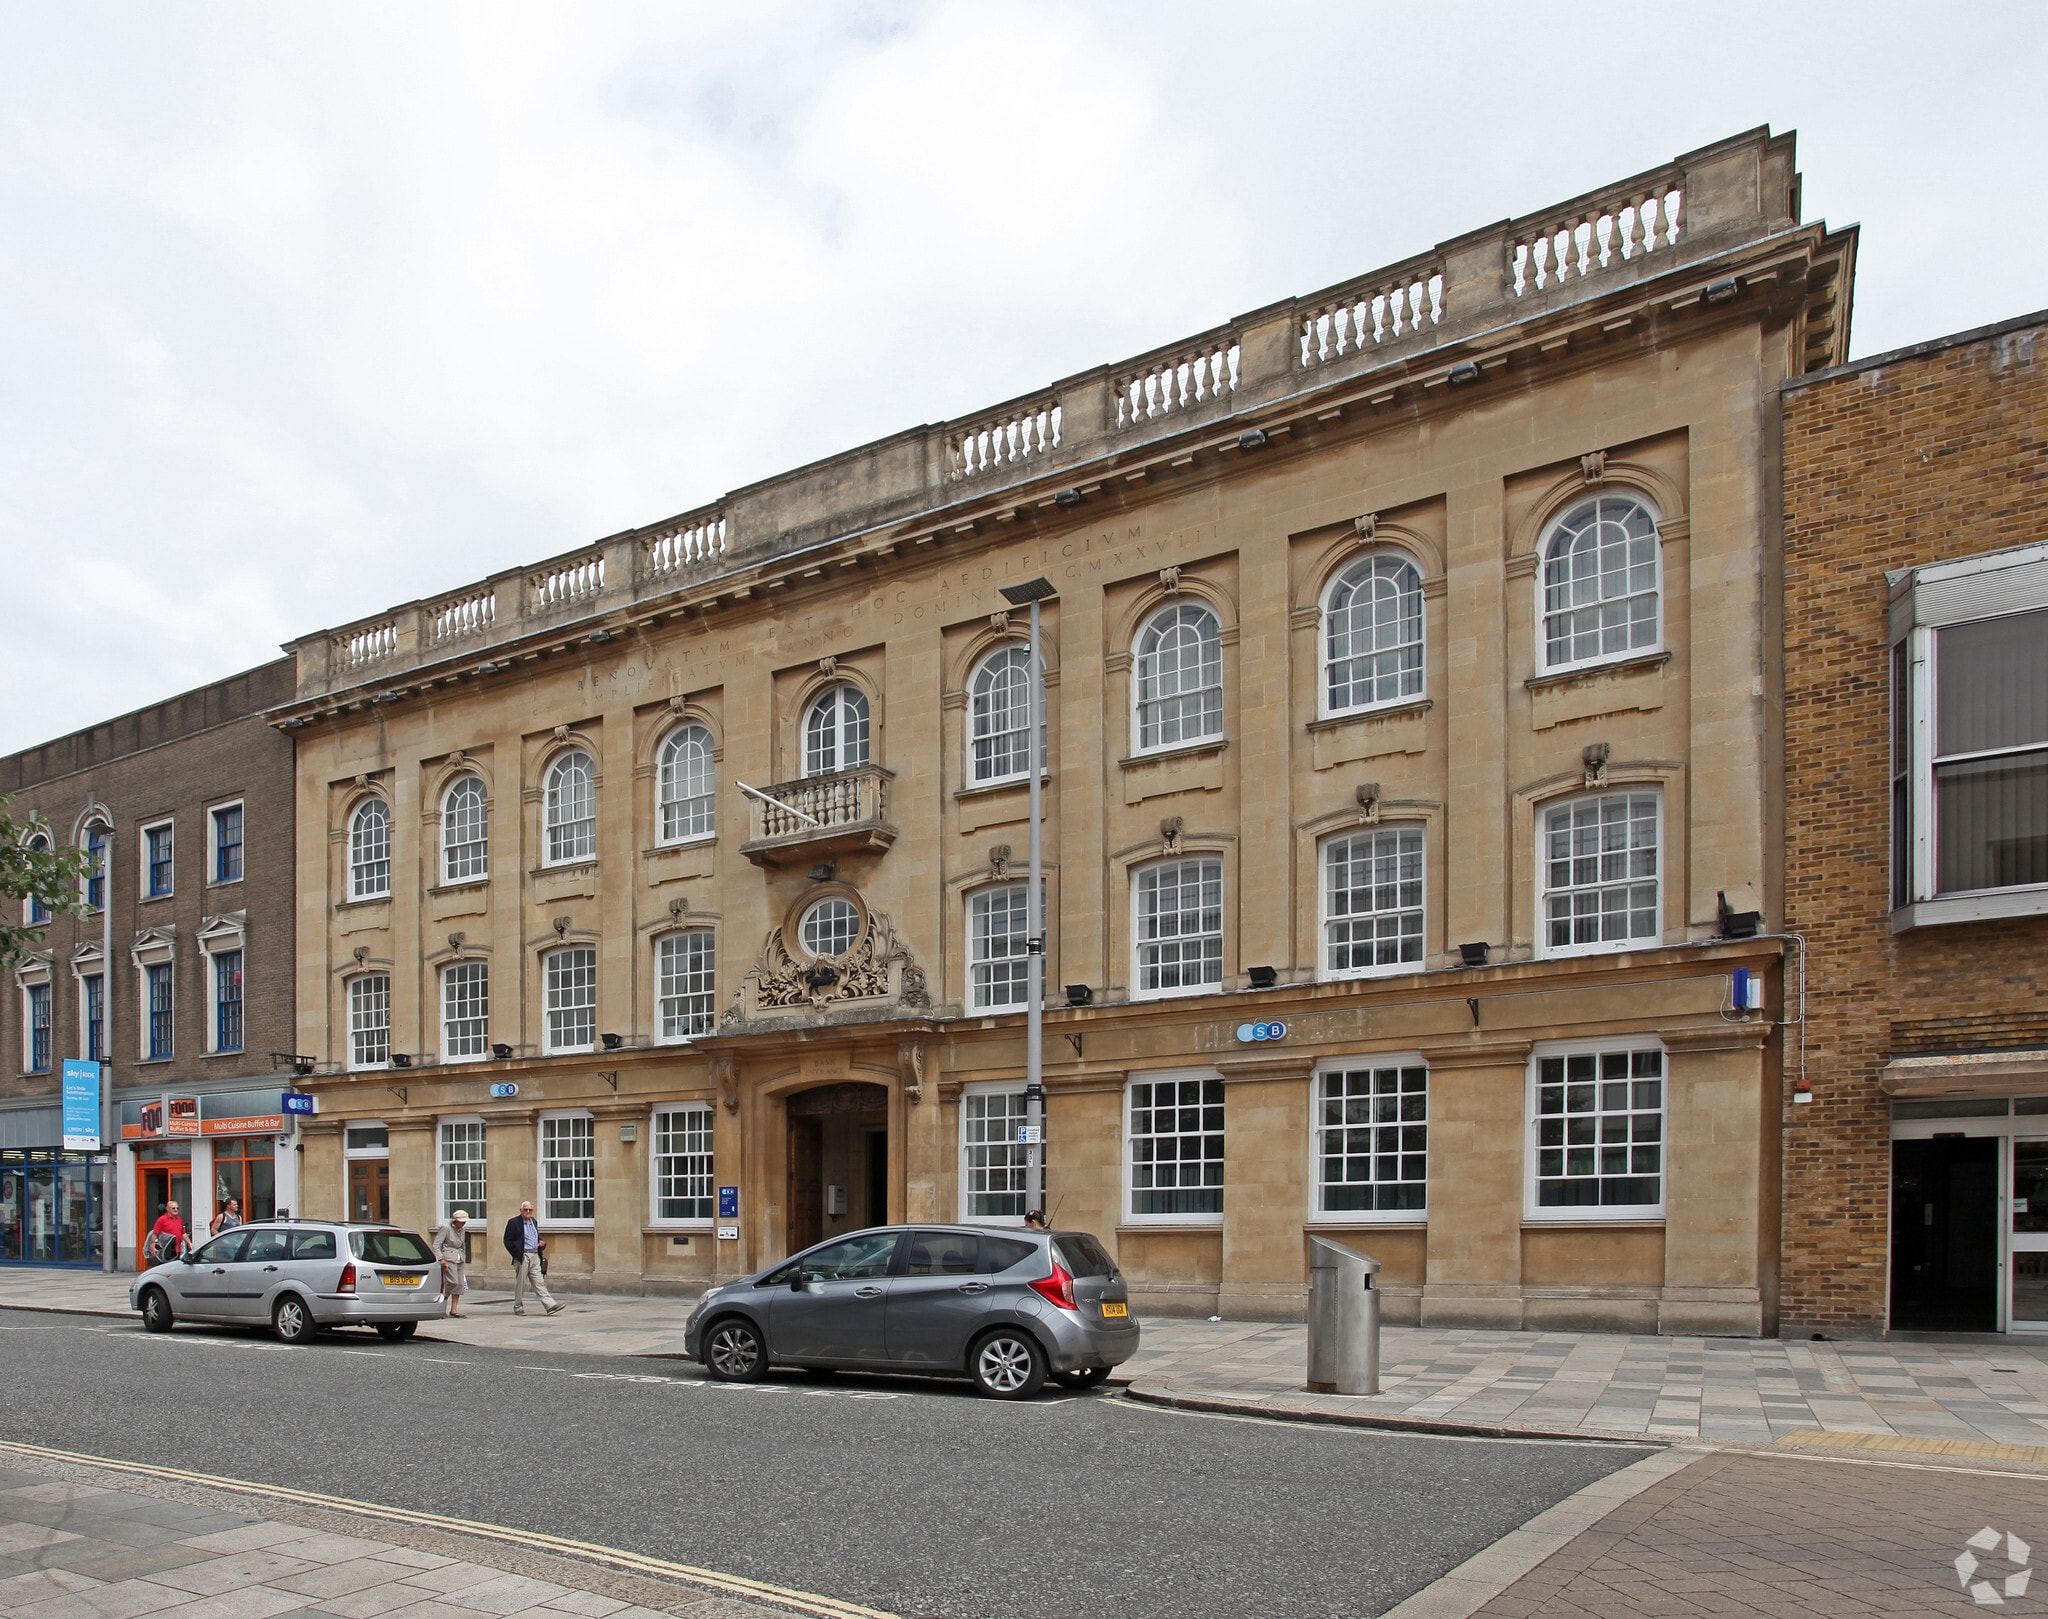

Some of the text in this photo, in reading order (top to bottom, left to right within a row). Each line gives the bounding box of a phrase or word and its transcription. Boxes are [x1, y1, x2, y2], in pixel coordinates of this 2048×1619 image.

[768, 616, 813, 639] EST
[851, 591, 906, 617] HOC
[940, 525, 1142, 592] AEDIFICIVM
[786, 626, 854, 653] ANNO
[894, 586, 996, 625] DOMINI
[169, 1102, 196, 1114] FOOD
[213, 1122, 227, 1130] Multi
[228, 1121, 247, 1129] Cuisine
[248, 1120, 264, 1128] Buffet
